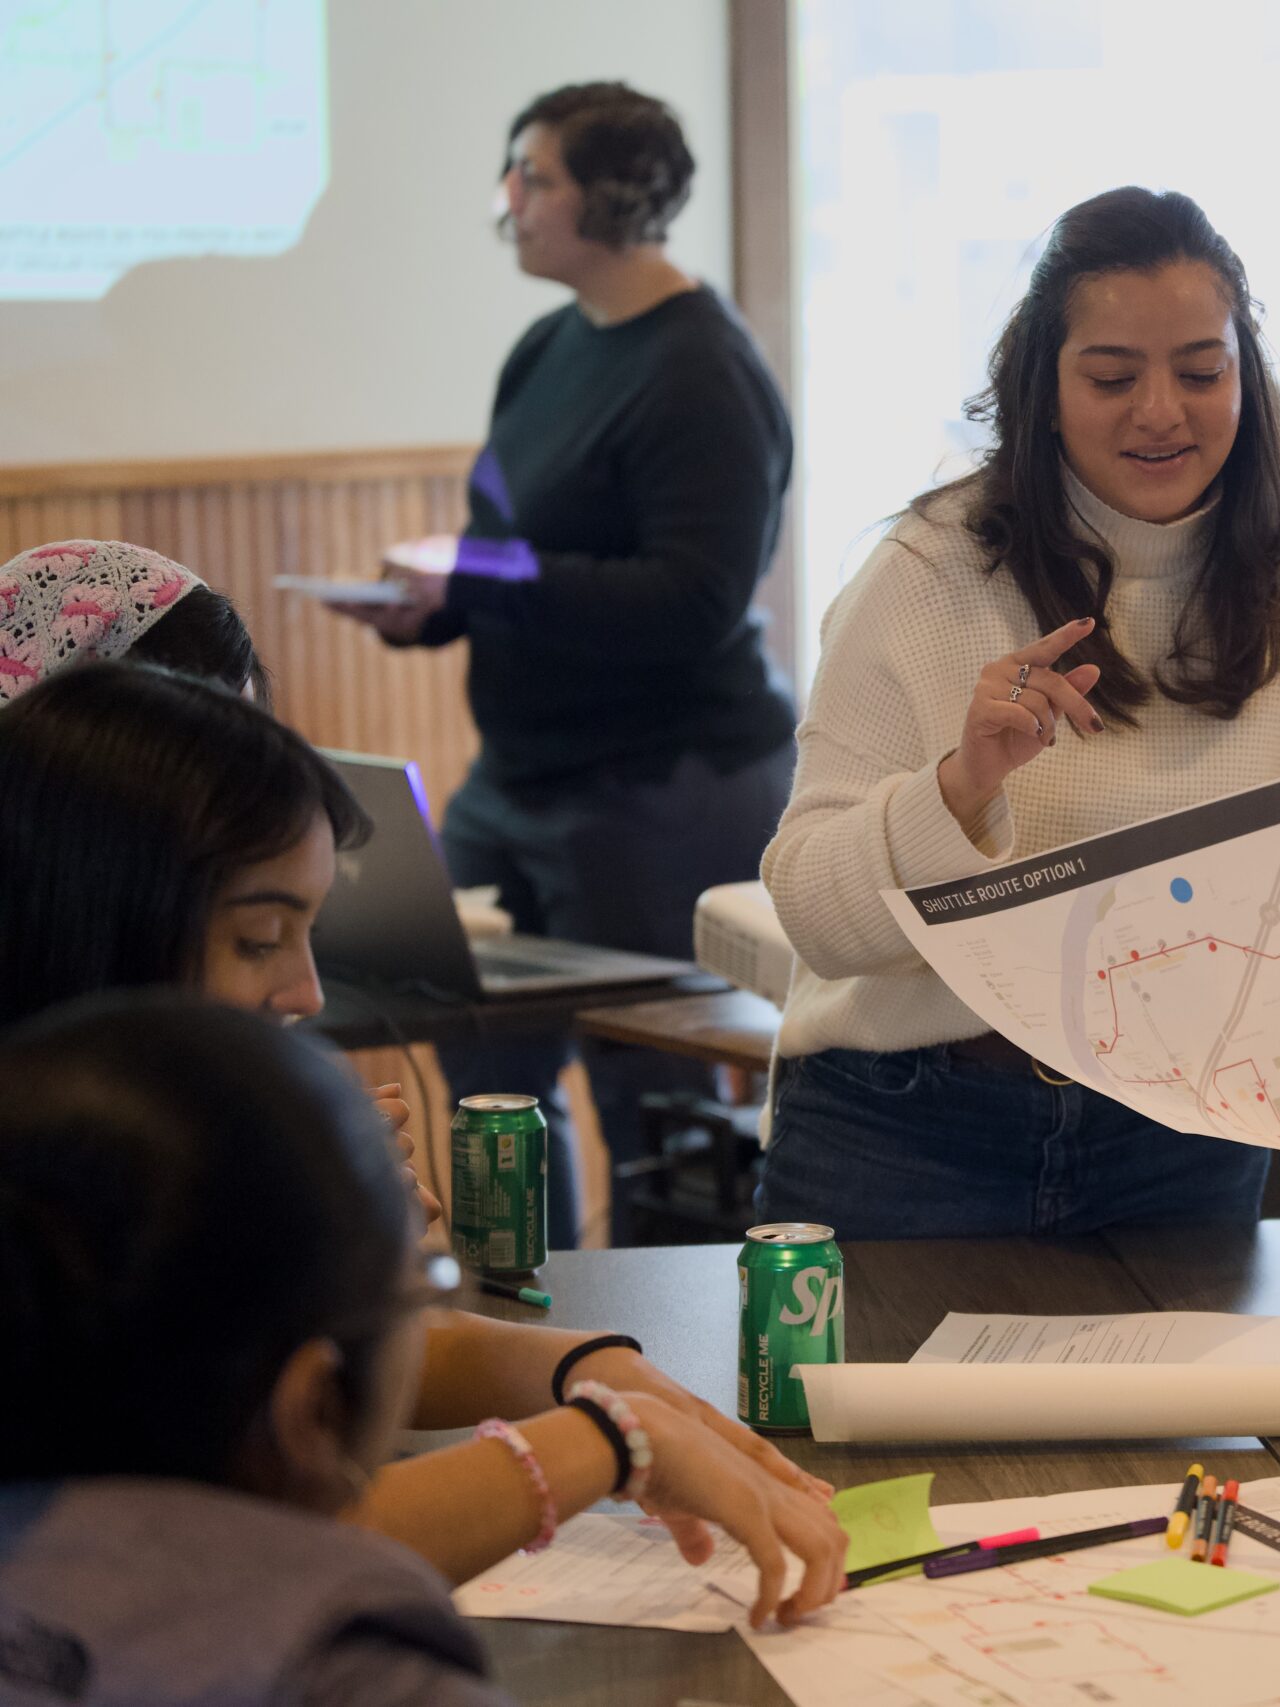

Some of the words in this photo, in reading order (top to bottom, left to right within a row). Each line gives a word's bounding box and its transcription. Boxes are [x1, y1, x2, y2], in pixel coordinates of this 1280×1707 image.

[922, 890, 977, 913] SHUTTLE
[976, 877, 1022, 901] ROUTE
[1023, 860, 1076, 888] OPTION
[1077, 857, 1086, 872] 1
[758, 1334, 769, 1356] ME
[758, 1359, 769, 1421] RECYCLE
